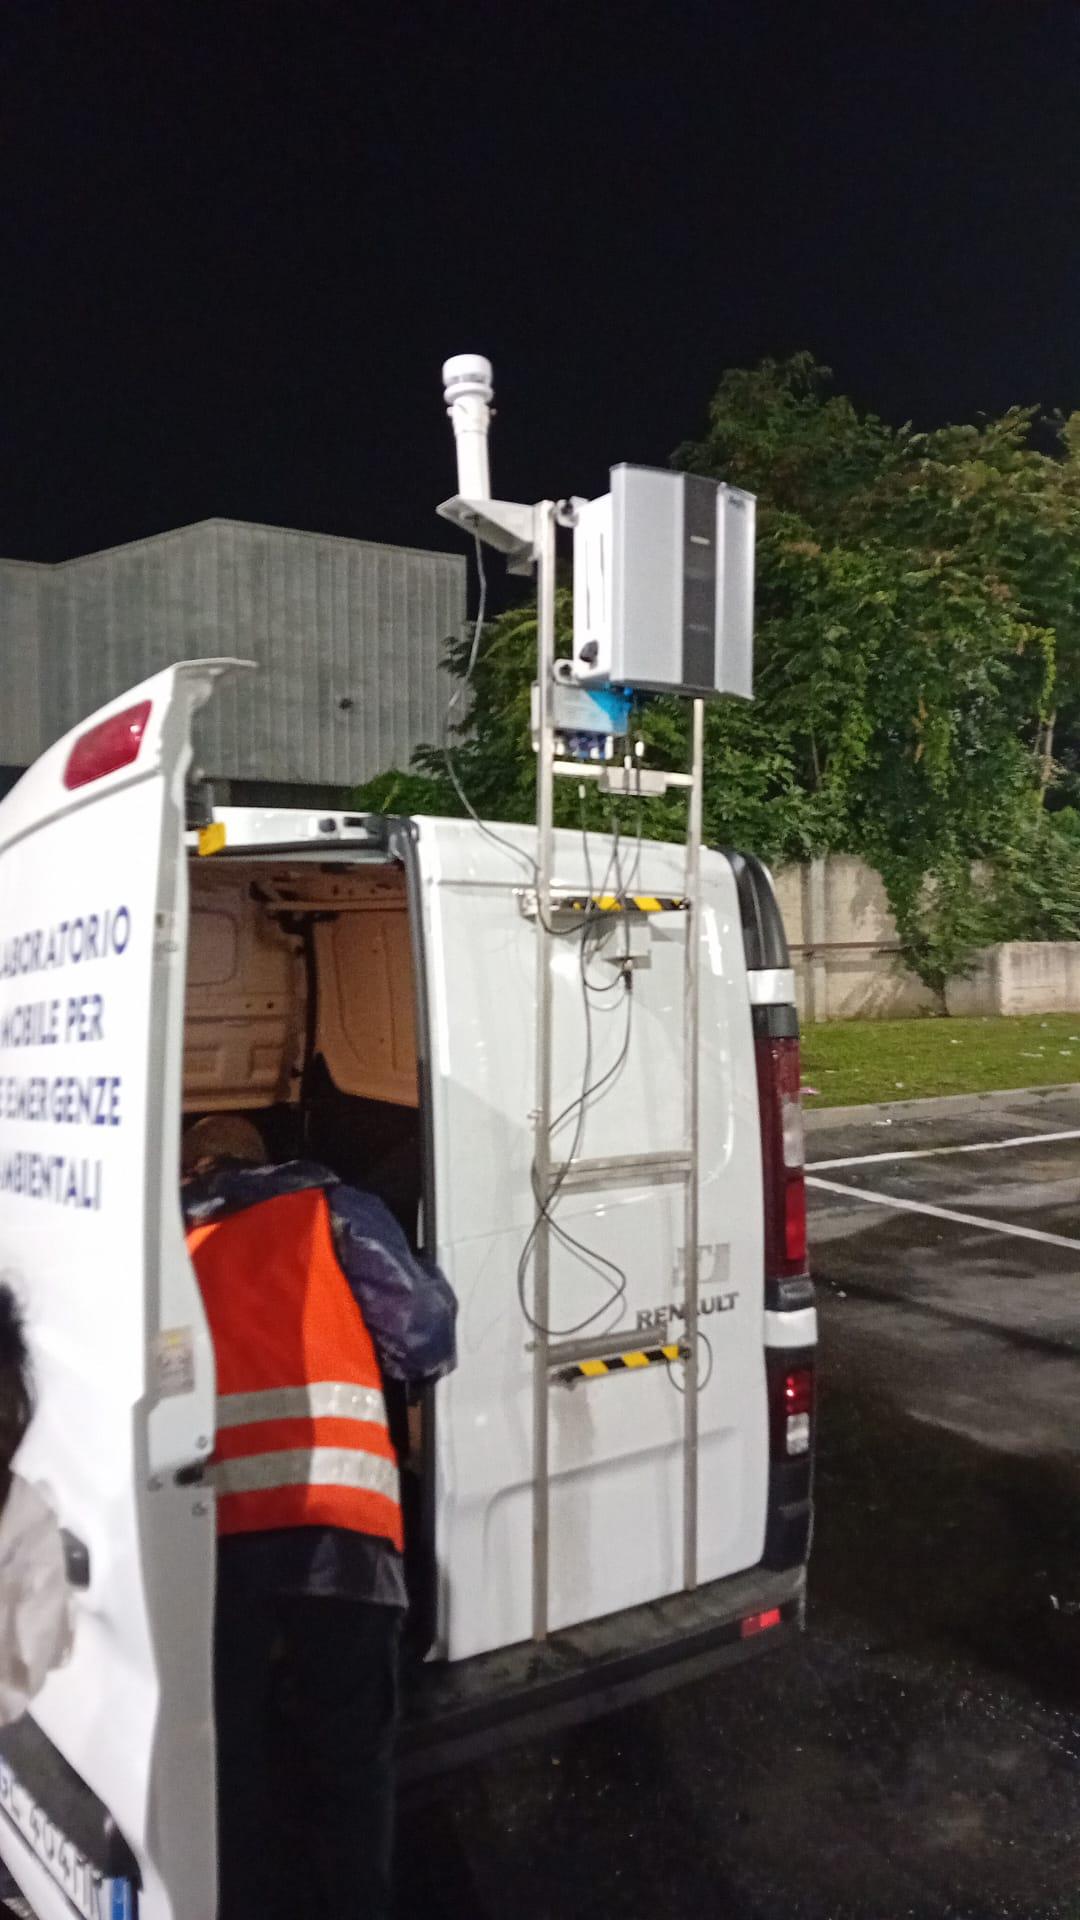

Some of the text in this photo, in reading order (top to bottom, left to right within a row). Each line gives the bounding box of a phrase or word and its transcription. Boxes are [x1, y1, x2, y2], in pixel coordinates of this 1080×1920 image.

[0, 905, 131, 979] ABORATORIO
[65, 993, 105, 1042] PER
[0, 1151, 102, 1210] MBIENTALI
[636, 1292, 739, 1330] RENULT
